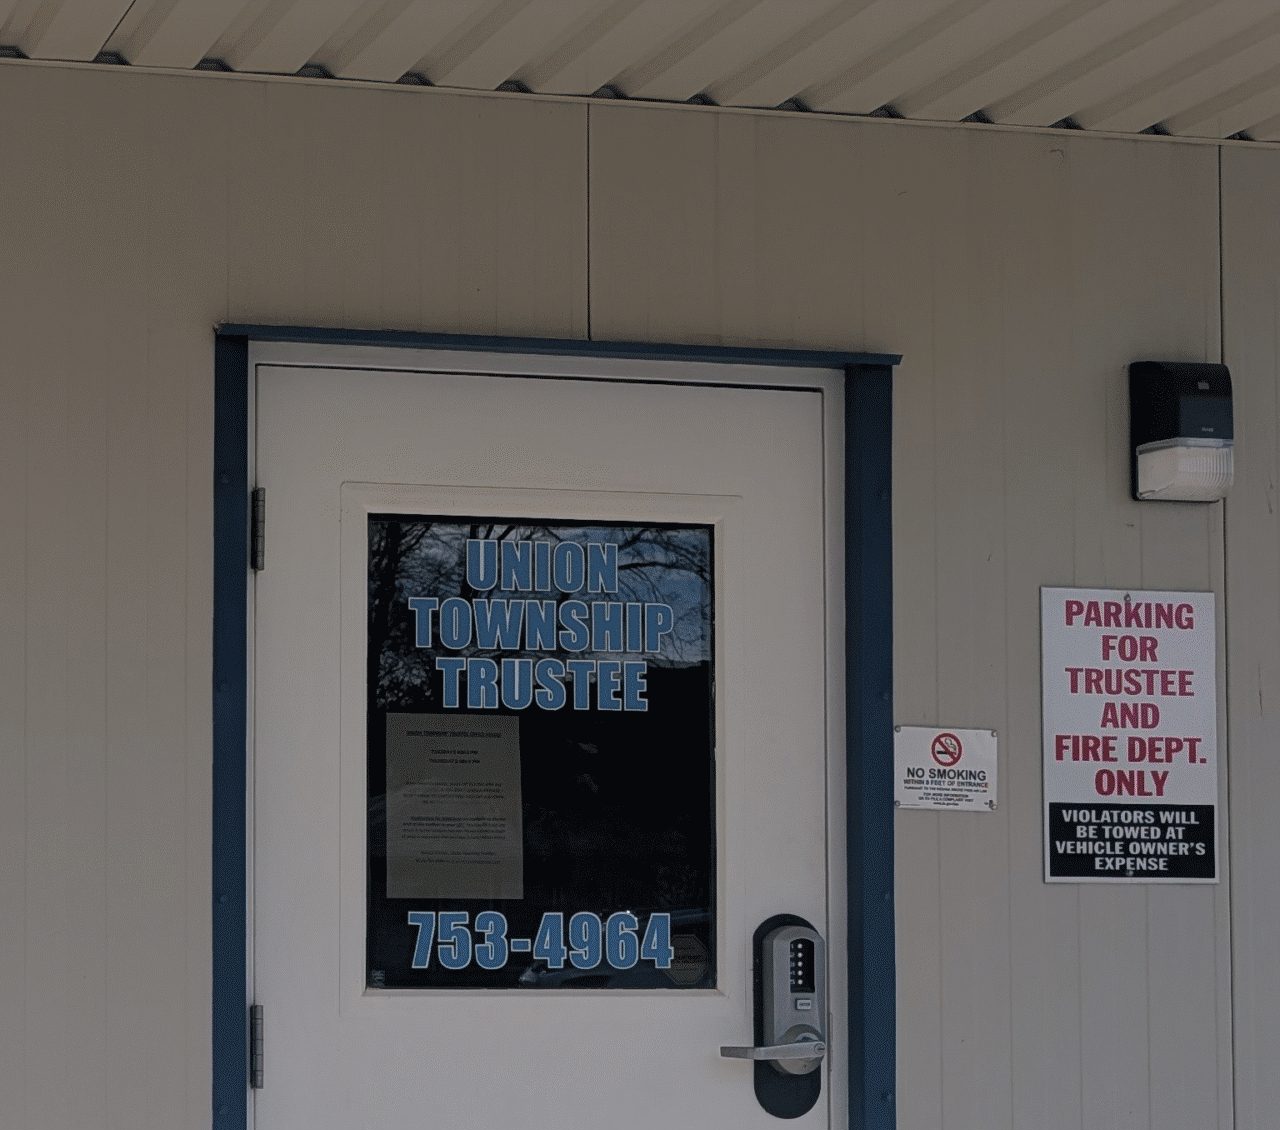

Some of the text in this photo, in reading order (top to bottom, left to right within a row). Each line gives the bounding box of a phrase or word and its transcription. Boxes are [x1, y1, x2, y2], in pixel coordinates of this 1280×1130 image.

[466, 538, 619, 593] UNION
[408, 597, 674, 653] TOWNSHIP
[1065, 599, 1195, 630] PARKING
[1101, 634, 1159, 662] FOR
[435, 657, 649, 712] TRUSTEE
[1064, 667, 1195, 697] TRUSTEE
[1100, 702, 1160, 729] AND
[1055, 734, 1207, 764] FIRE DEPT.
[907, 767, 987, 781] NO SMOKING
[957, 781, 989, 789] ENTRANCE
[1094, 768, 1170, 797] ONLY
[1061, 809, 1200, 825] VIOLATORS WILL
[1076, 825, 1186, 840] BE TOWED AT
[1055, 840, 1206, 856] VEHICLE OWNER'S
[1094, 857, 1169, 871] EXPENSE
[407, 911, 675, 970] 753-4964
